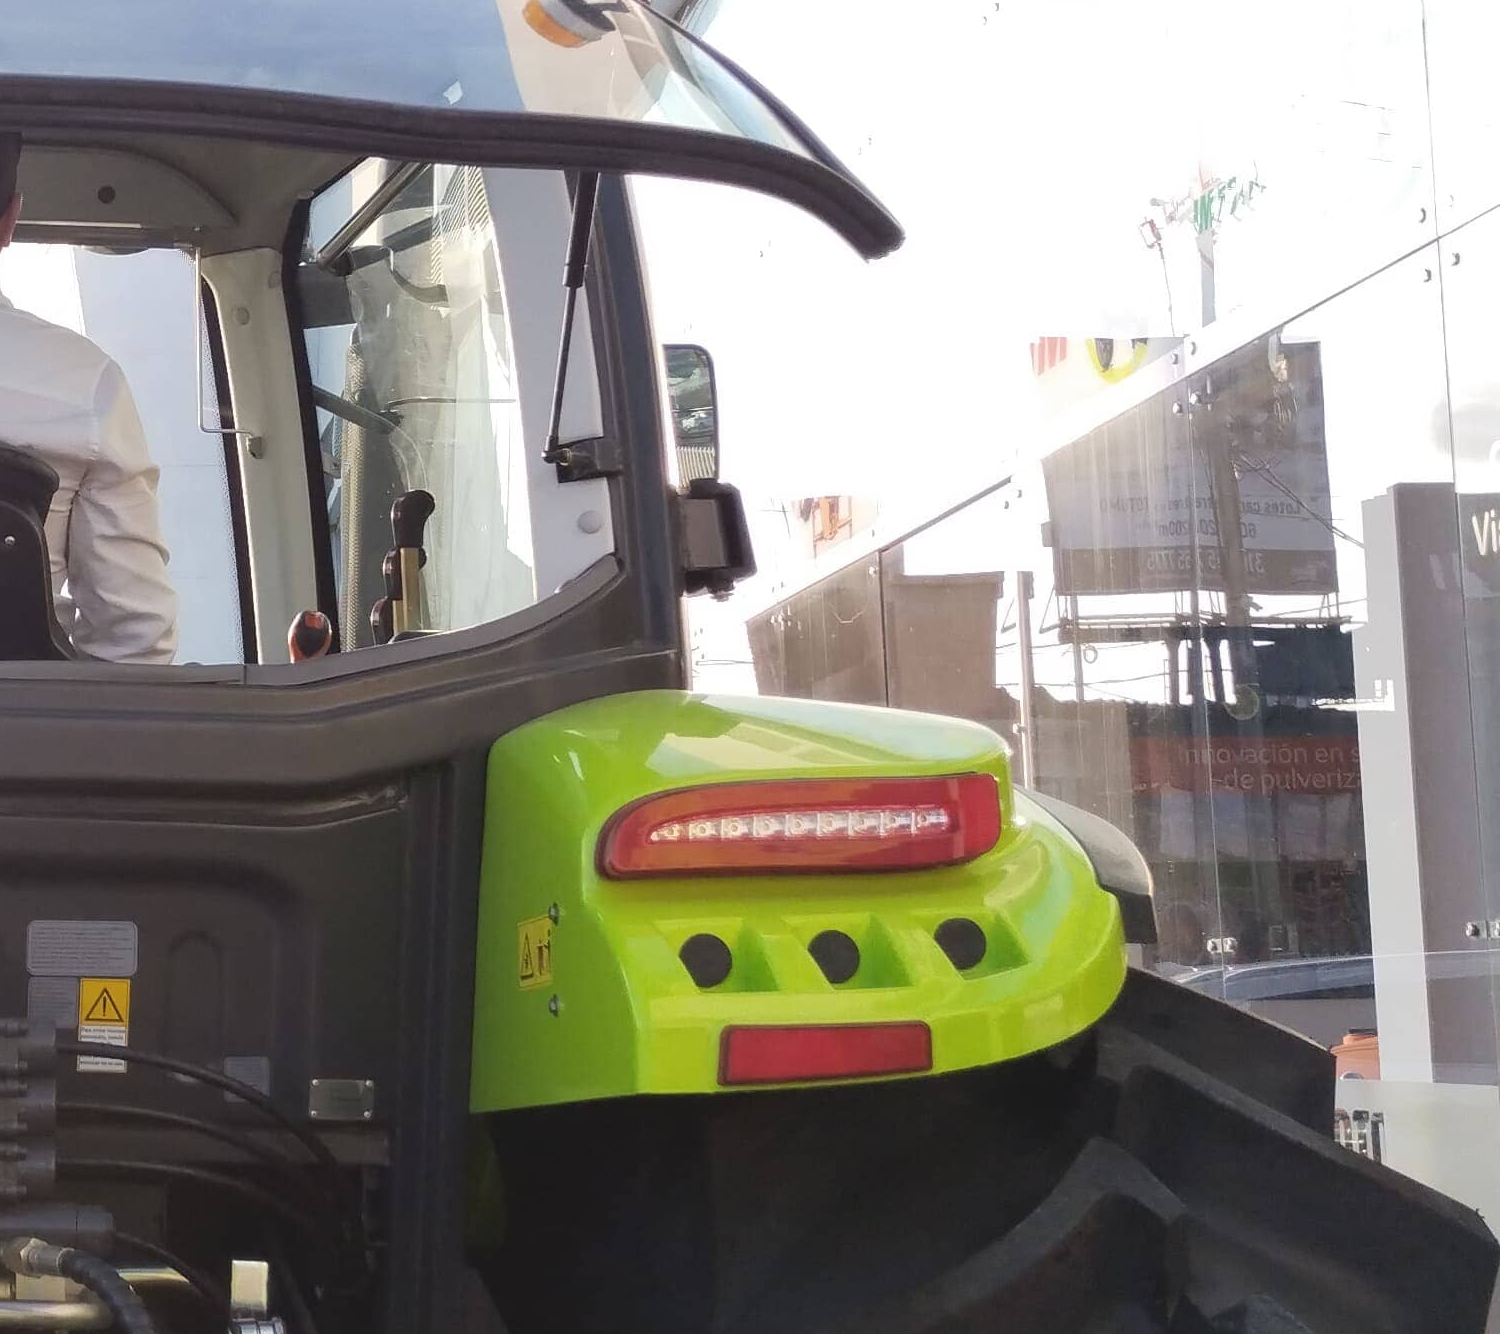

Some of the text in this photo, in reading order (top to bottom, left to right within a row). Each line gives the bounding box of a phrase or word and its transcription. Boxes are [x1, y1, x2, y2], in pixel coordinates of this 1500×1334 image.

[1471, 508, 1500, 556] Vi
[1315, 745, 1344, 764] en
[1223, 768, 1362, 795] de pulveriz
